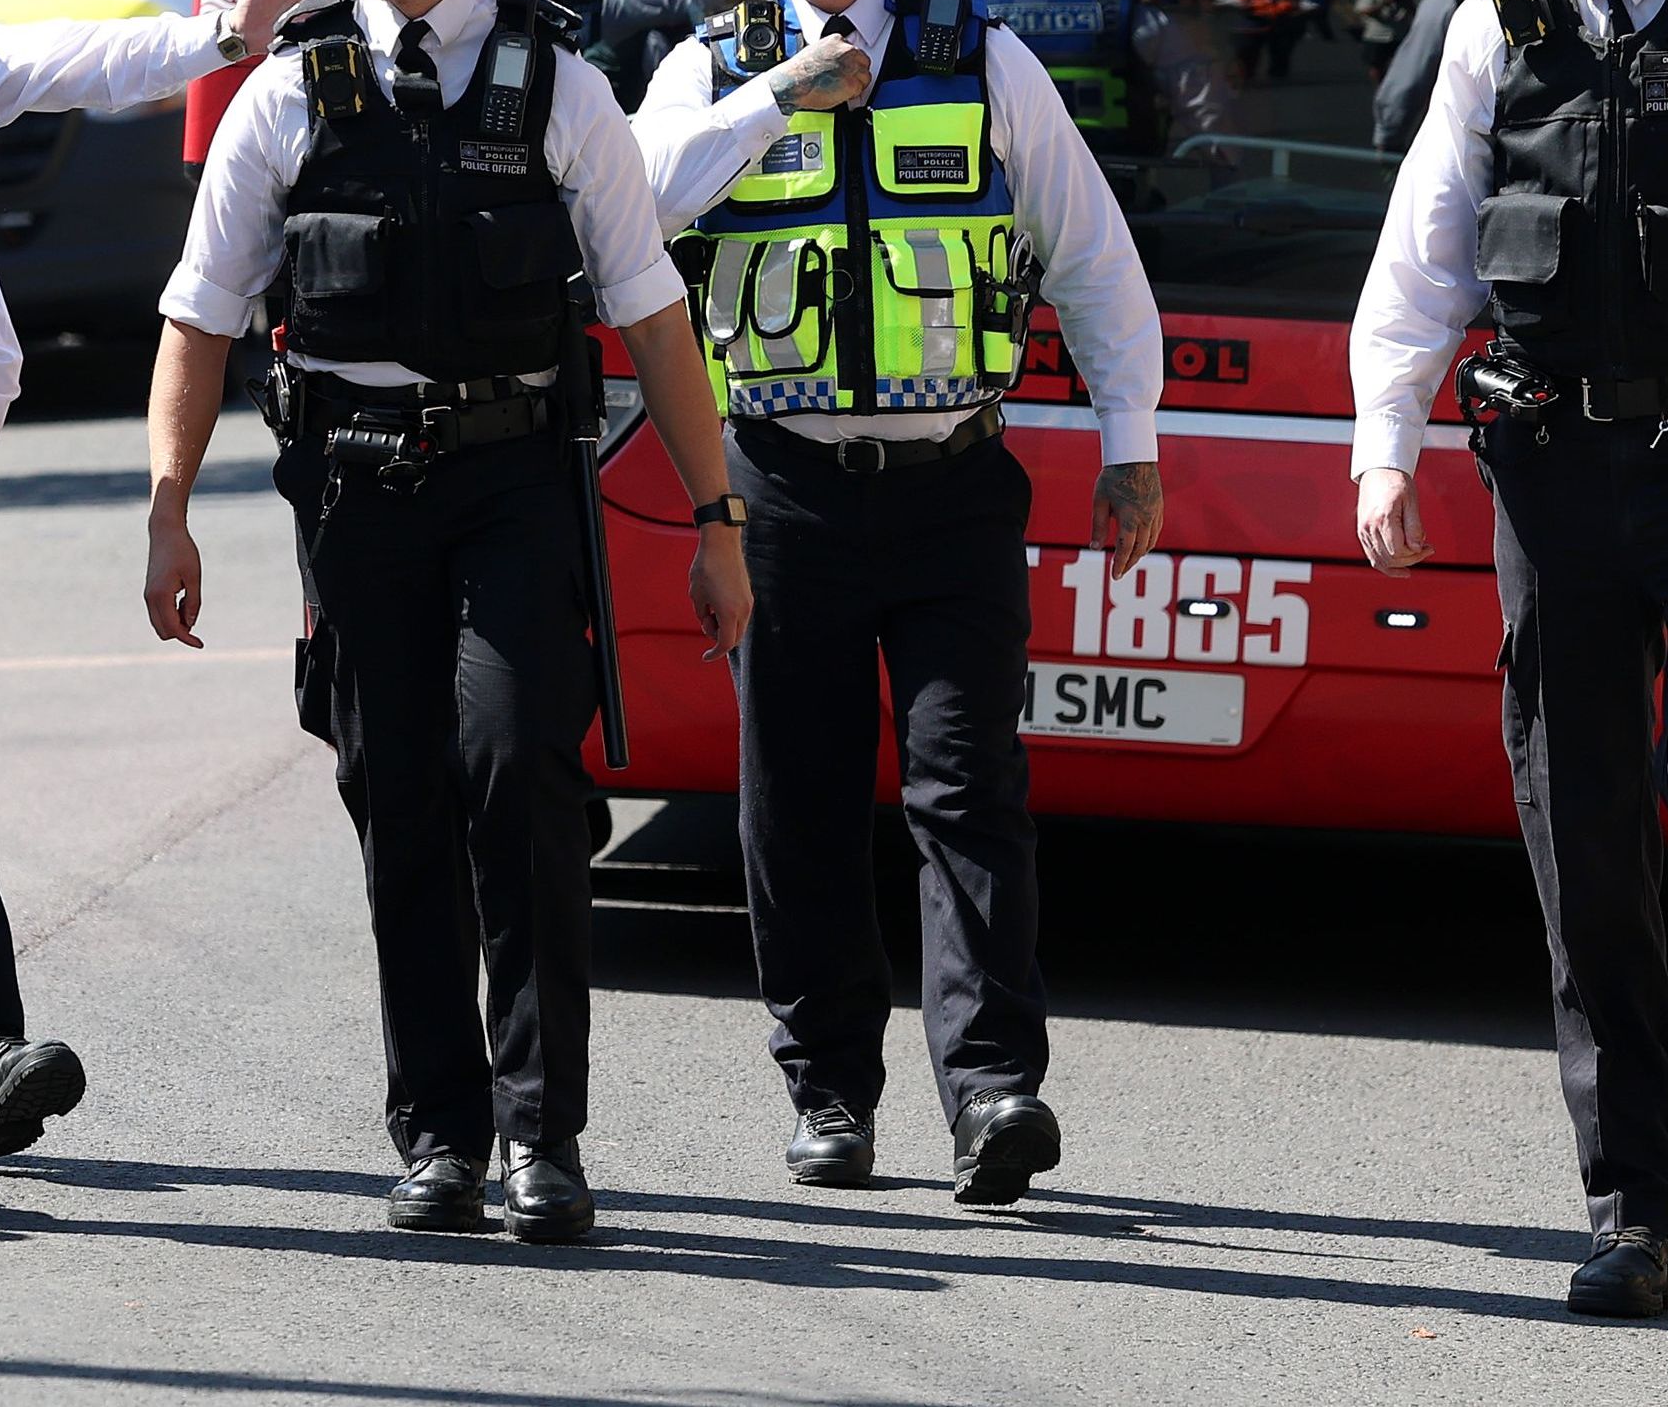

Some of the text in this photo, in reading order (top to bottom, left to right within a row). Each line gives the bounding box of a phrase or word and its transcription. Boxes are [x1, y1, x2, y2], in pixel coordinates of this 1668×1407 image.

[480, 145, 526, 153] METROPOLITAN
[460, 161, 527, 174] POLICE OFFICER
[899, 170, 964, 179] POLICE OFFICER
[1062, 549, 1313, 667] 1865
[1055, 673, 1167, 731] SMC
